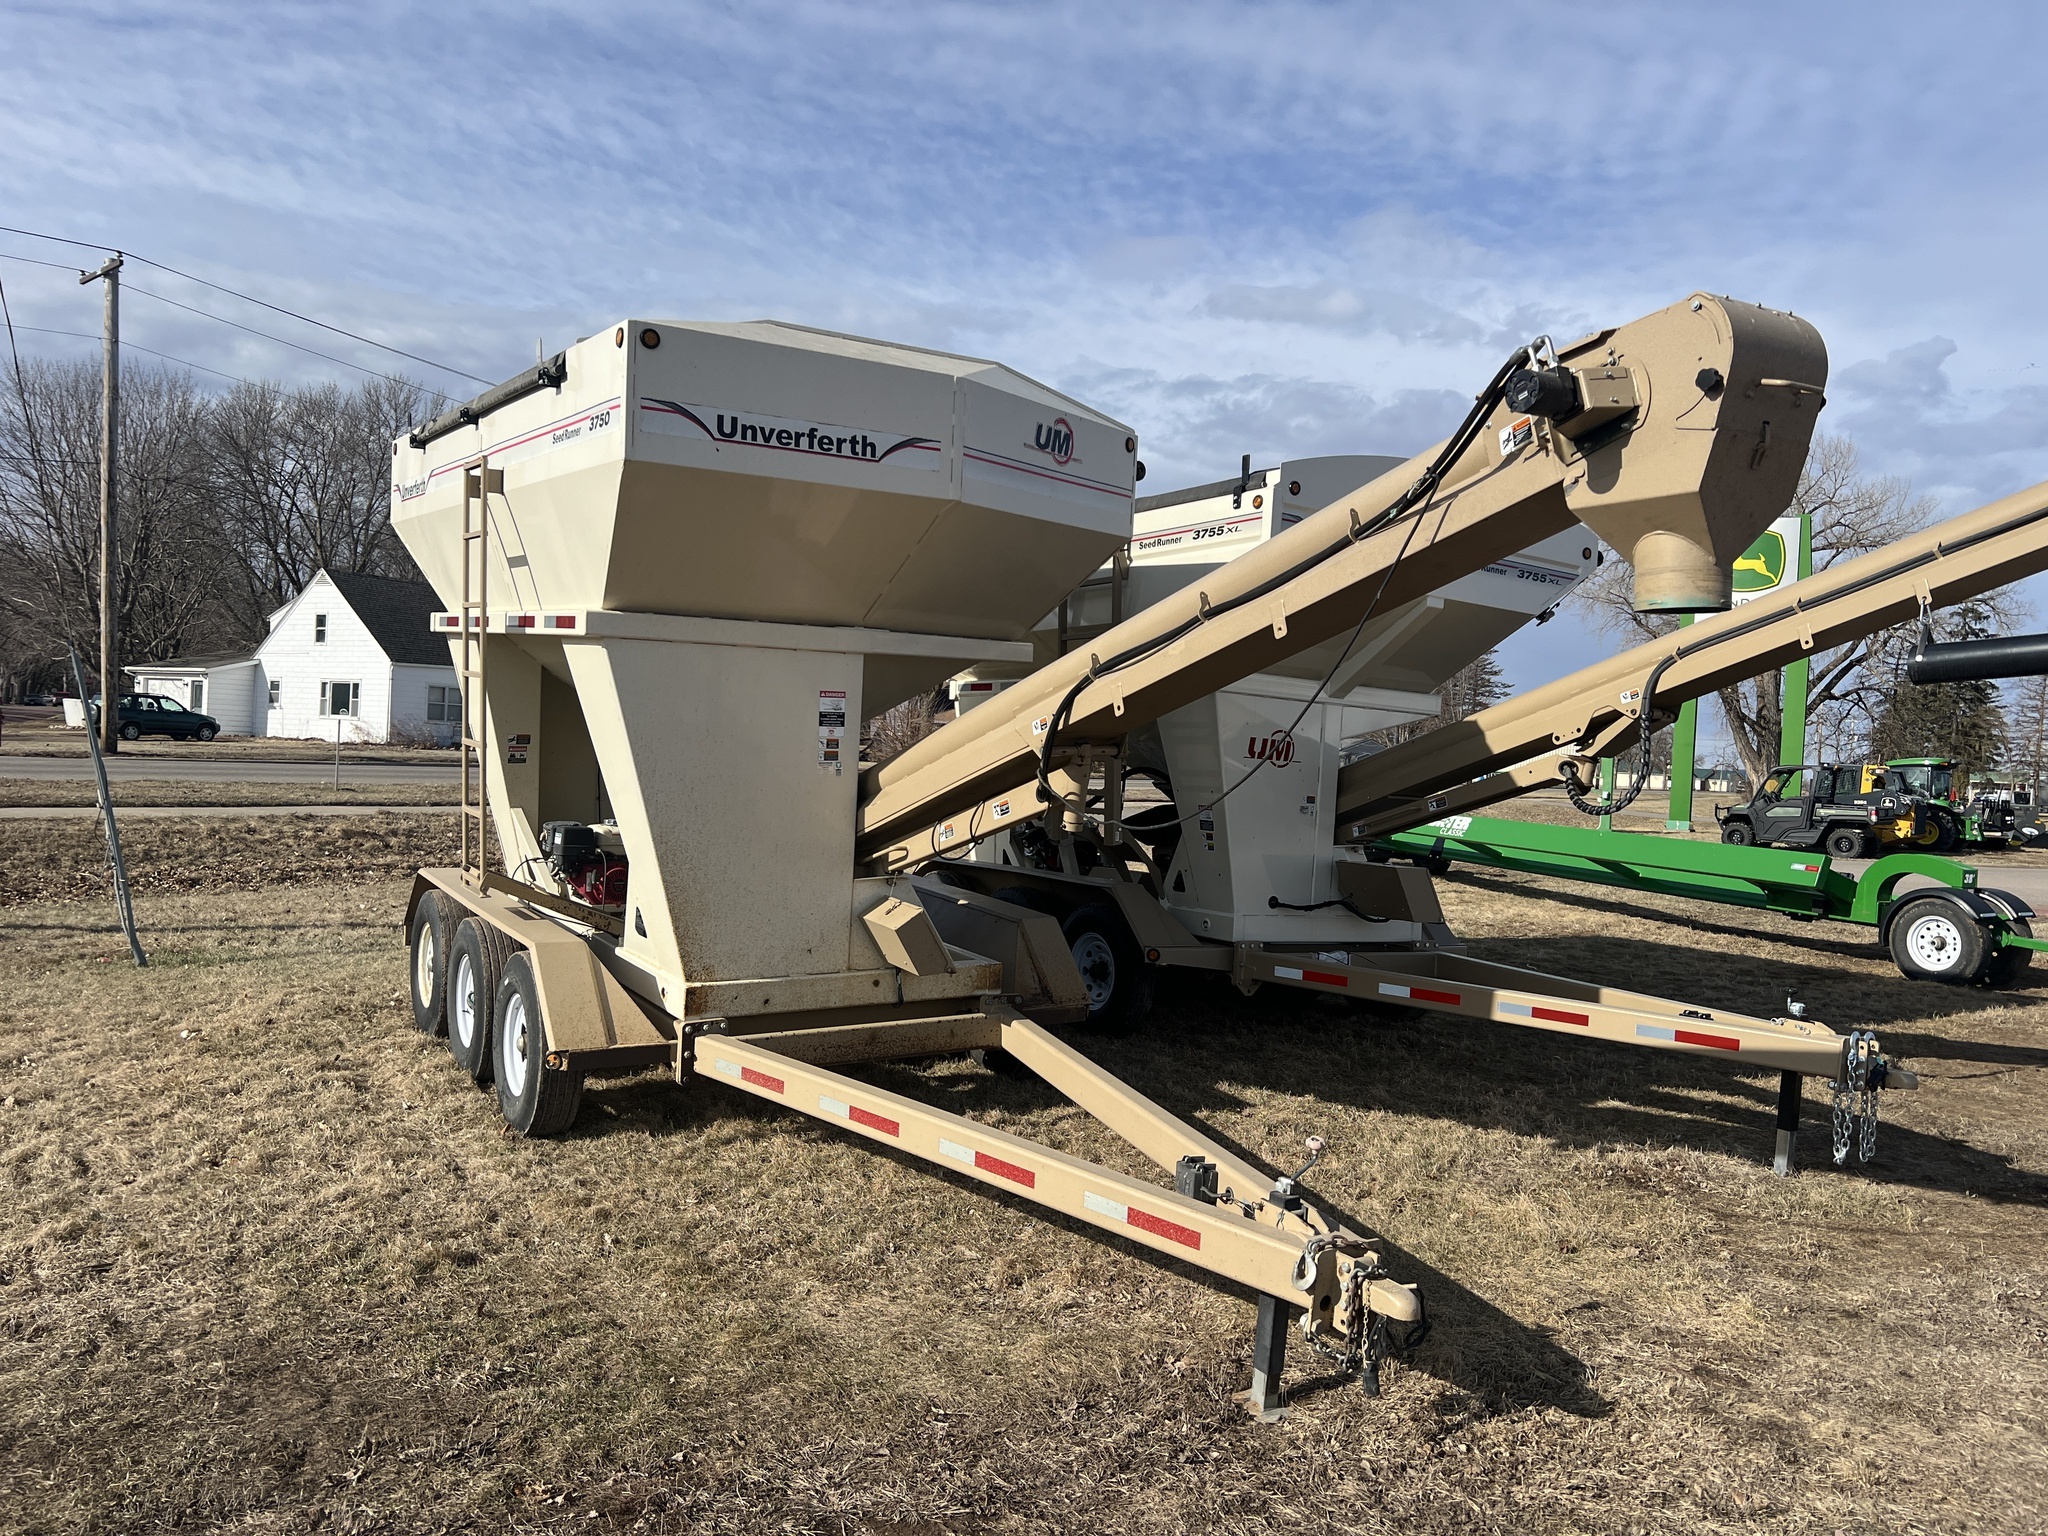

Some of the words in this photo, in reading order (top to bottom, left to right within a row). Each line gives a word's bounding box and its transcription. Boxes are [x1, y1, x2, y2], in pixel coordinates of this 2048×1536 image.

[589, 410, 610, 431] 3750
[716, 414, 877, 458] Unverferth
[1035, 422, 1071, 456] UM
[402, 477, 426, 500] Unverferth
[1247, 737, 1292, 762] UM
[1440, 828, 1466, 837] CLASSIC
